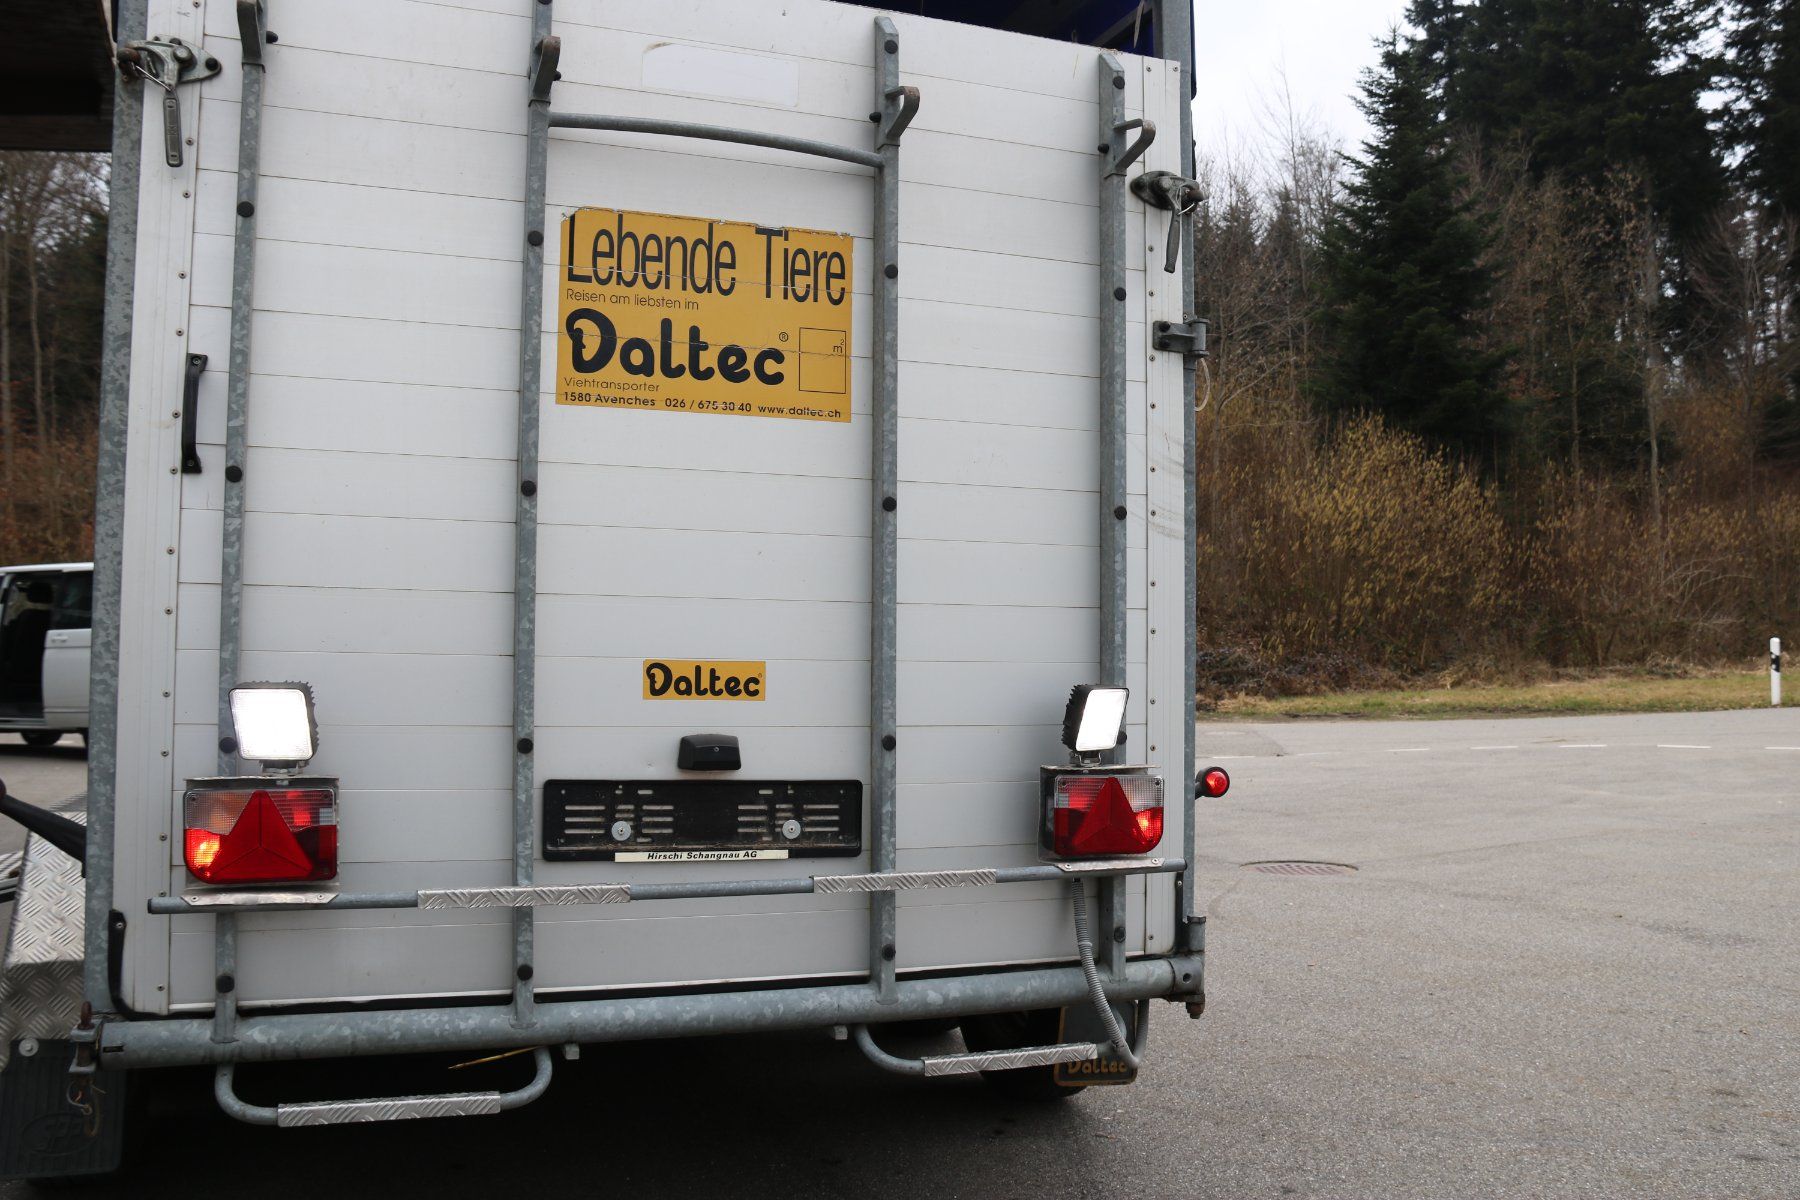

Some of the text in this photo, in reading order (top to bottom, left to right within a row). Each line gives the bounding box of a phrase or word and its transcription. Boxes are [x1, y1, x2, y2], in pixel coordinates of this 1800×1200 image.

[567, 213, 847, 306] Lebende Tiere
[566, 288, 699, 310] Reisen am liebsten im
[565, 307, 785, 386] Daltec
[564, 377, 660, 392] Viehtransporter
[564, 391, 592, 403] 1580
[594, 393, 656, 406] Avenches
[664, 398, 686, 408] 026
[697, 400, 719, 411] 675
[721, 401, 736, 412] 30
[738, 402, 752, 412] 40
[757, 405, 841, 418] www.daltec.ch
[645, 662, 761, 697] Daltec
[647, 850, 758, 861] Hirschi Schangnau AG
